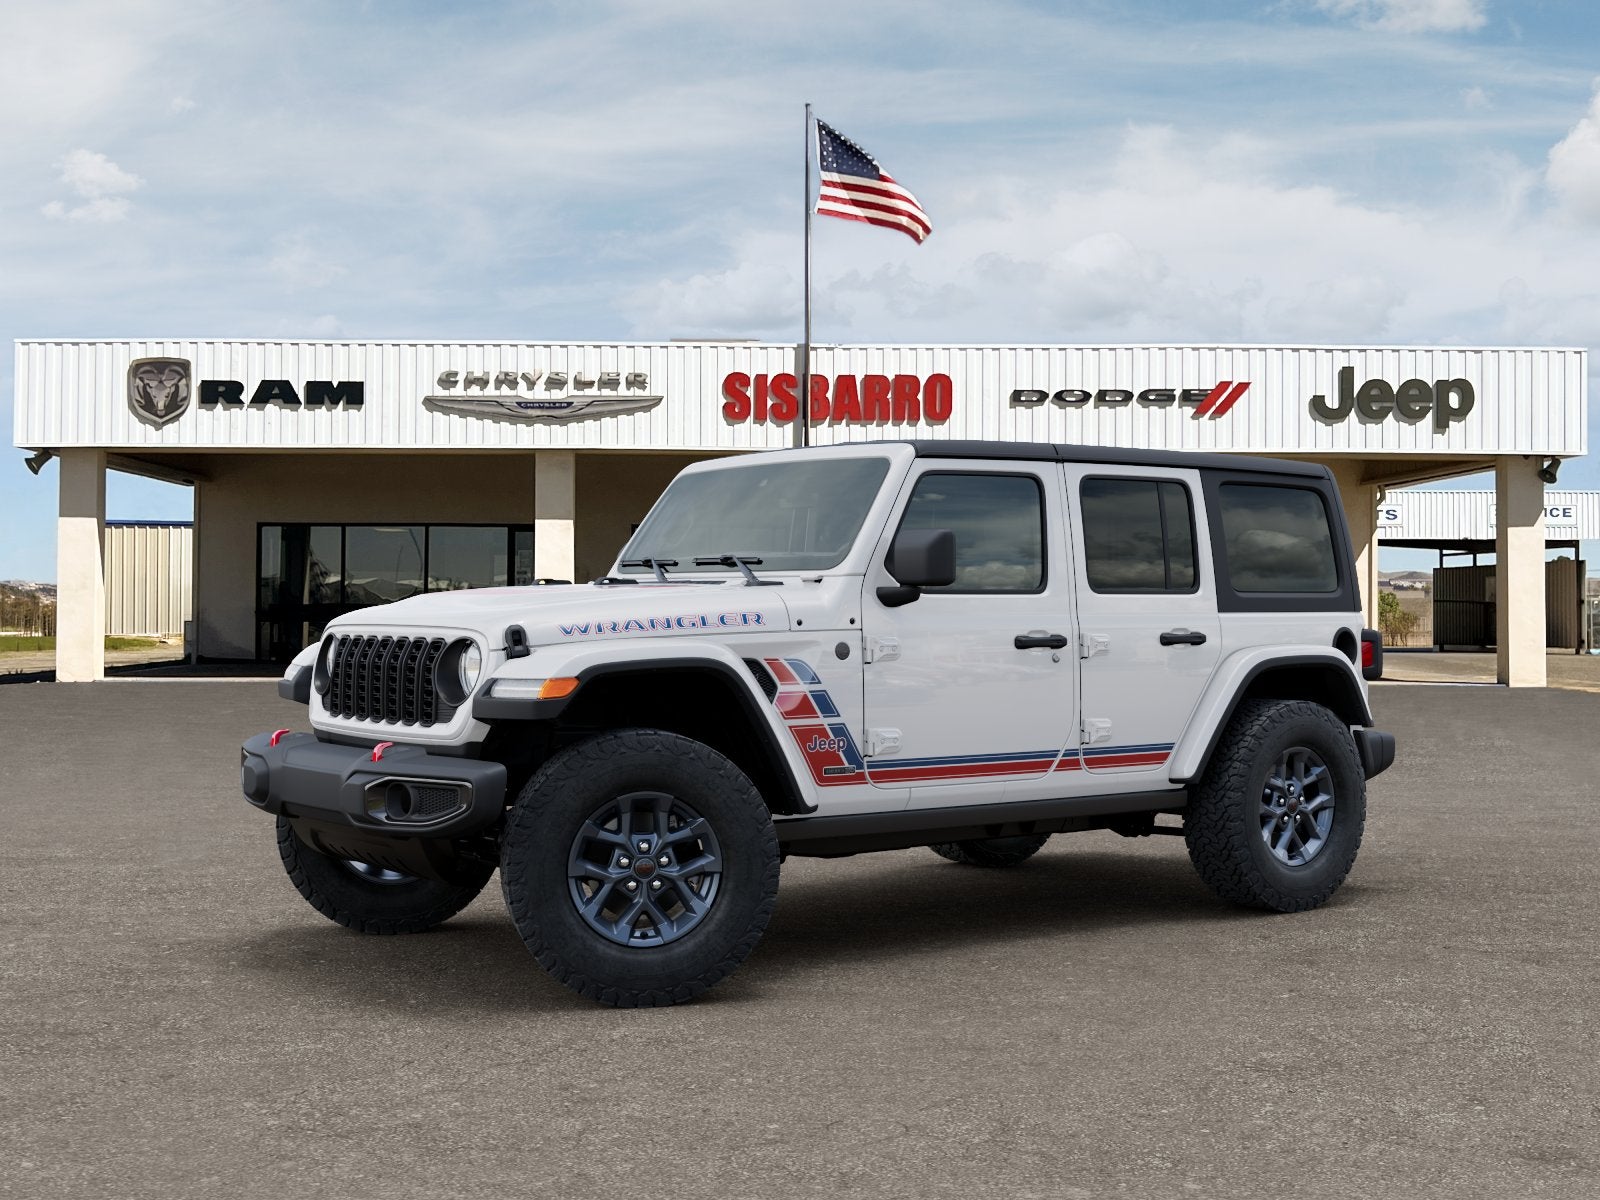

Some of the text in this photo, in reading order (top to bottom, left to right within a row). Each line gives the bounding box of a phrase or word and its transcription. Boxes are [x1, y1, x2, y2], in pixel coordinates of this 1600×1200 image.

[437, 370, 648, 389] CHRYSLER
[200, 380, 364, 405] RAM
[722, 372, 952, 421] SISBARRO
[1010, 389, 1216, 404] DODGE
[1311, 366, 1474, 428] Jeep
[558, 611, 766, 636] WRANGLER
[807, 735, 847, 753] Jeep
